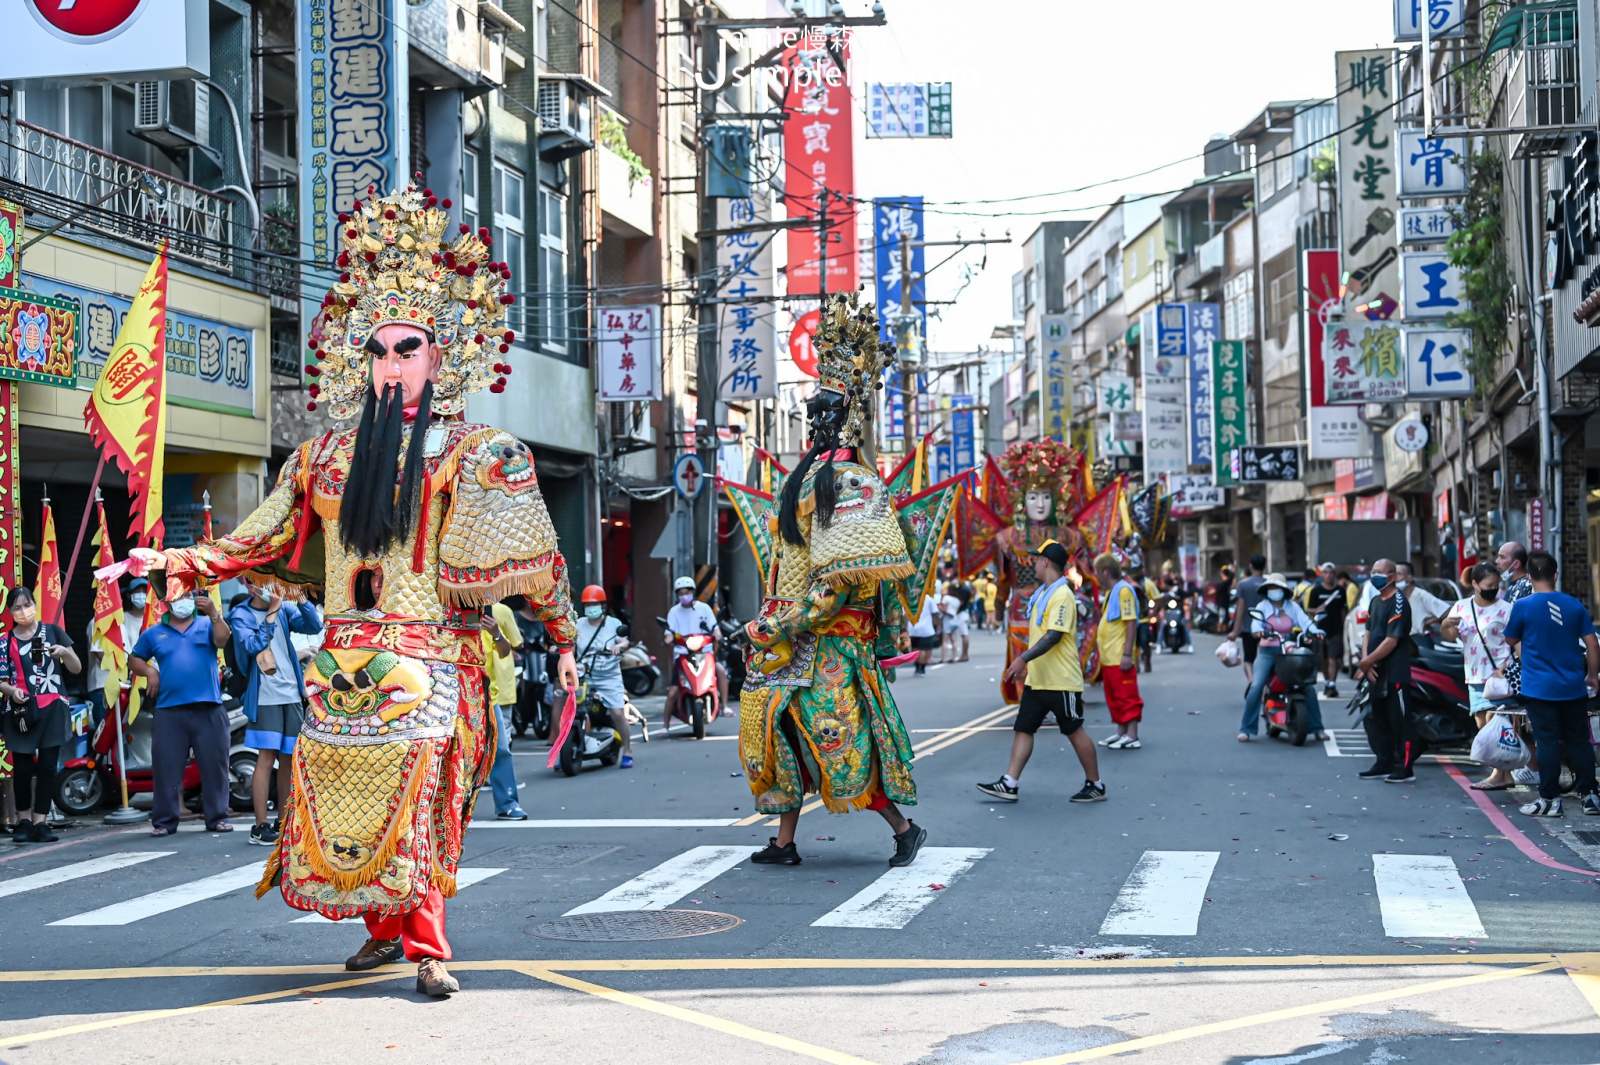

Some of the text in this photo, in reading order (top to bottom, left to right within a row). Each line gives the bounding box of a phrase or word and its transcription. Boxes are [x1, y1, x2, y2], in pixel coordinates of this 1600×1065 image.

[1349, 55, 1392, 200] 順光堂
[1410, 138, 1455, 187] 骨
[1407, 214, 1459, 235] 技術
[607, 312, 648, 332] 弘記
[1160, 307, 1184, 354] 植牙
[200, 330, 248, 387] 診所
[618, 333, 637, 393] 中藥房
[1418, 338, 1463, 386] 仁
